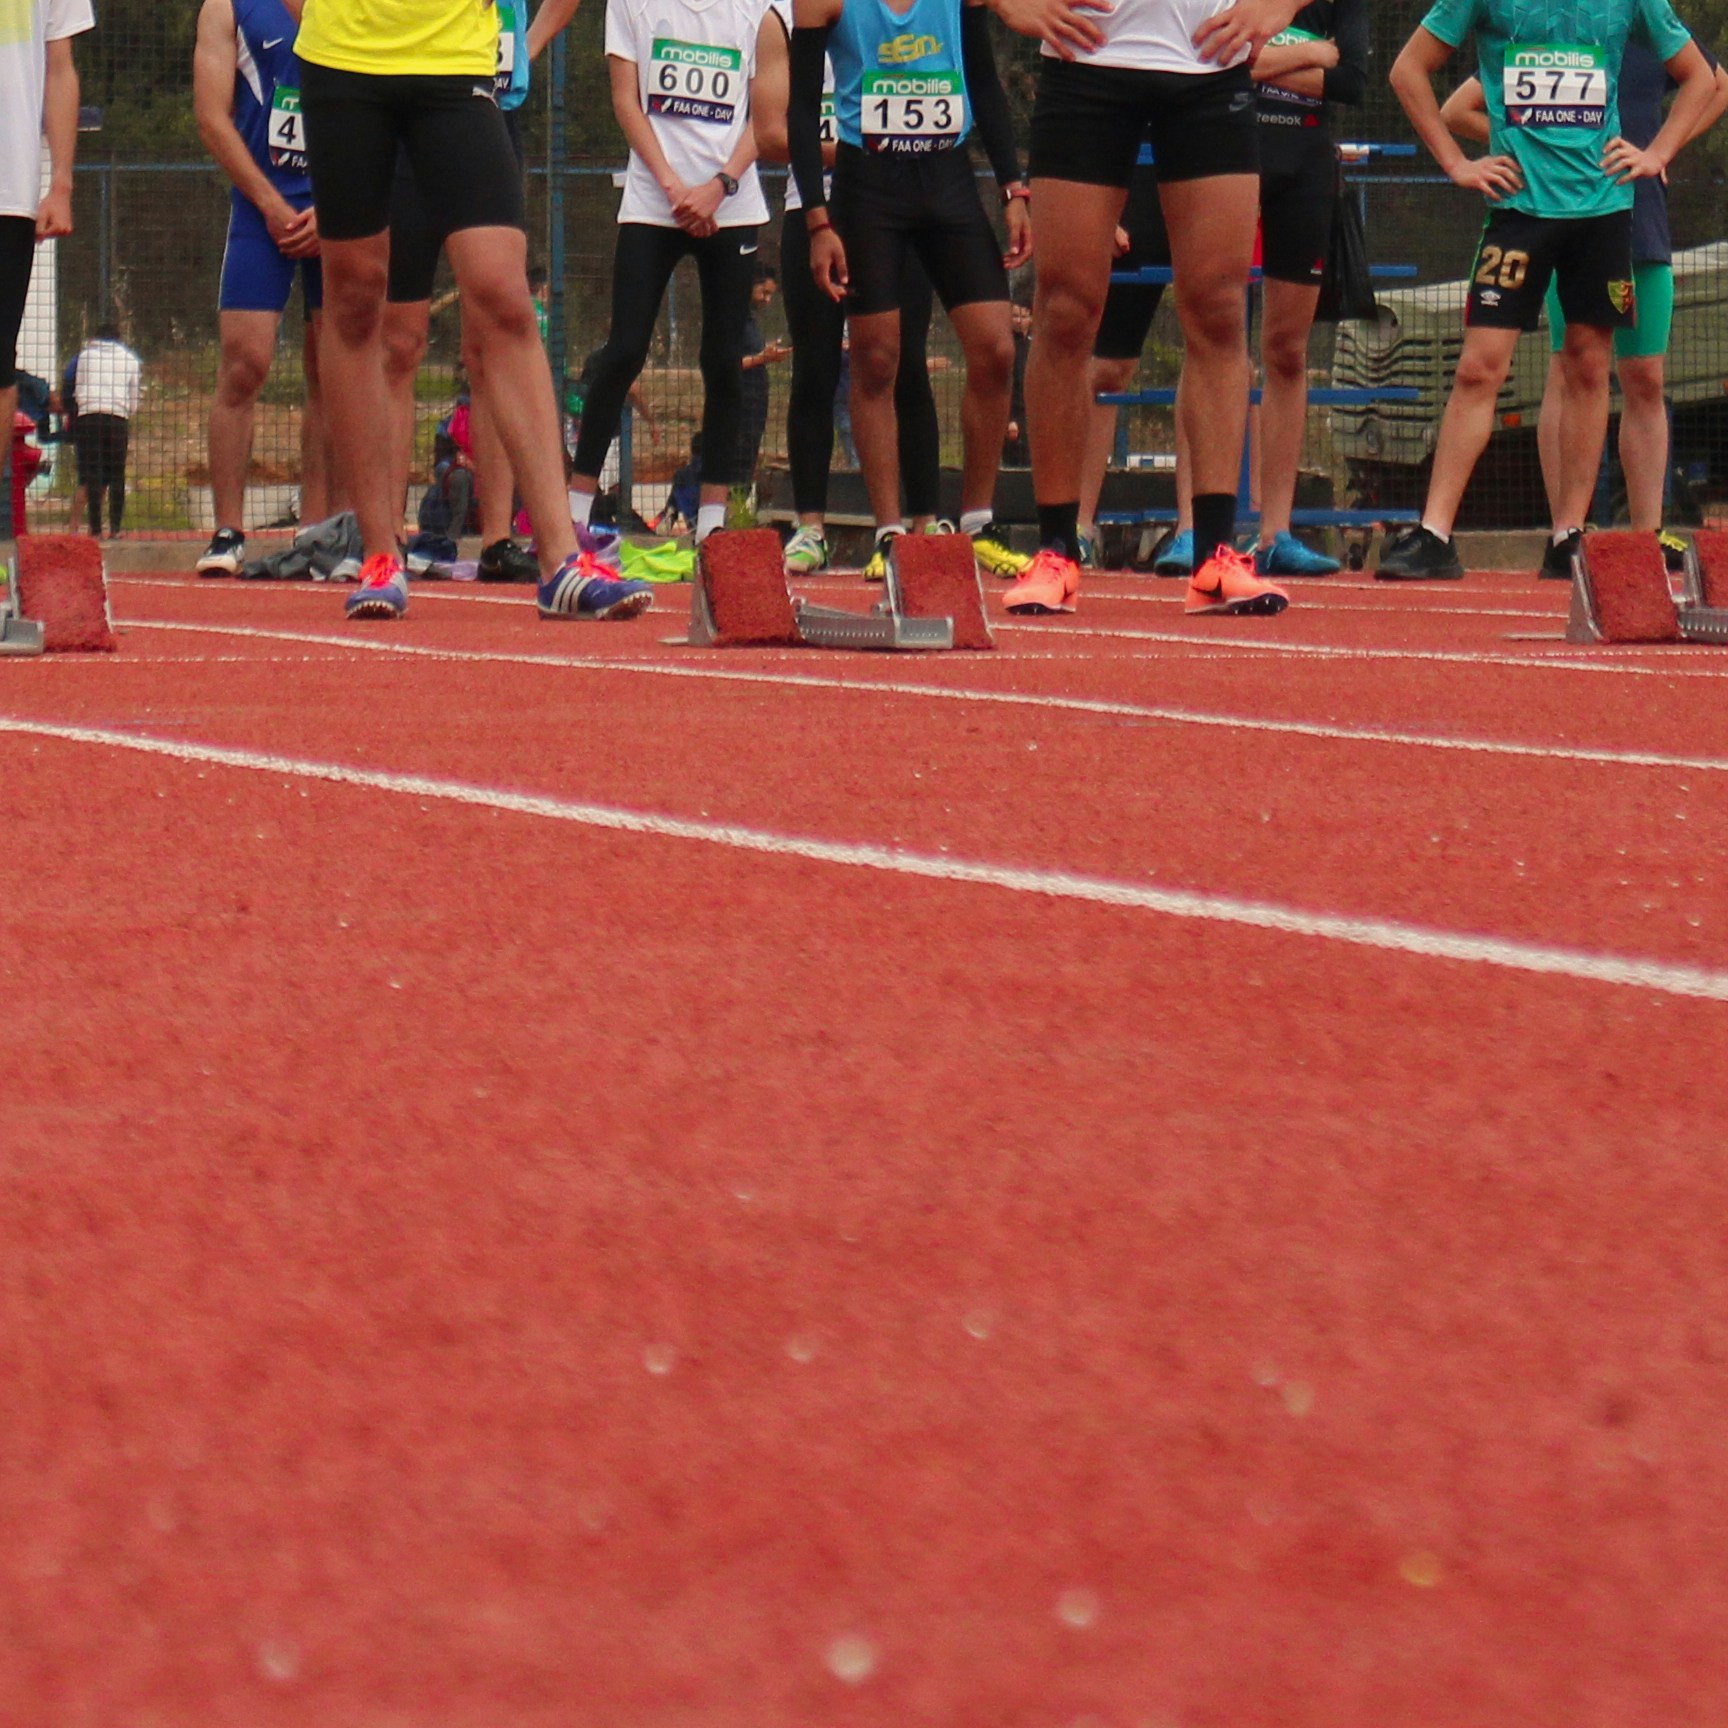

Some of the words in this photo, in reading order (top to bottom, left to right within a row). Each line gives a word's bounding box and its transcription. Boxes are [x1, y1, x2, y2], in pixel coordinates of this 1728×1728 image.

[661, 47, 732, 68] mobilis
[1515, 50, 1594, 68] mobilis
[659, 64, 729, 99] 600
[873, 78, 952, 94] mobilis
[1515, 71, 1595, 100] 577
[673, 101, 691, 114] FAA
[692, 104, 709, 118] ONE
[874, 98, 952, 130] 153
[1535, 111, 1554, 122] FAA
[1556, 111, 1576, 123] ONE
[1583, 111, 1603, 124] DAY
[892, 140, 912, 153] FAA
[913, 139, 932, 153] ONE
[1475, 245, 1530, 290] 20
